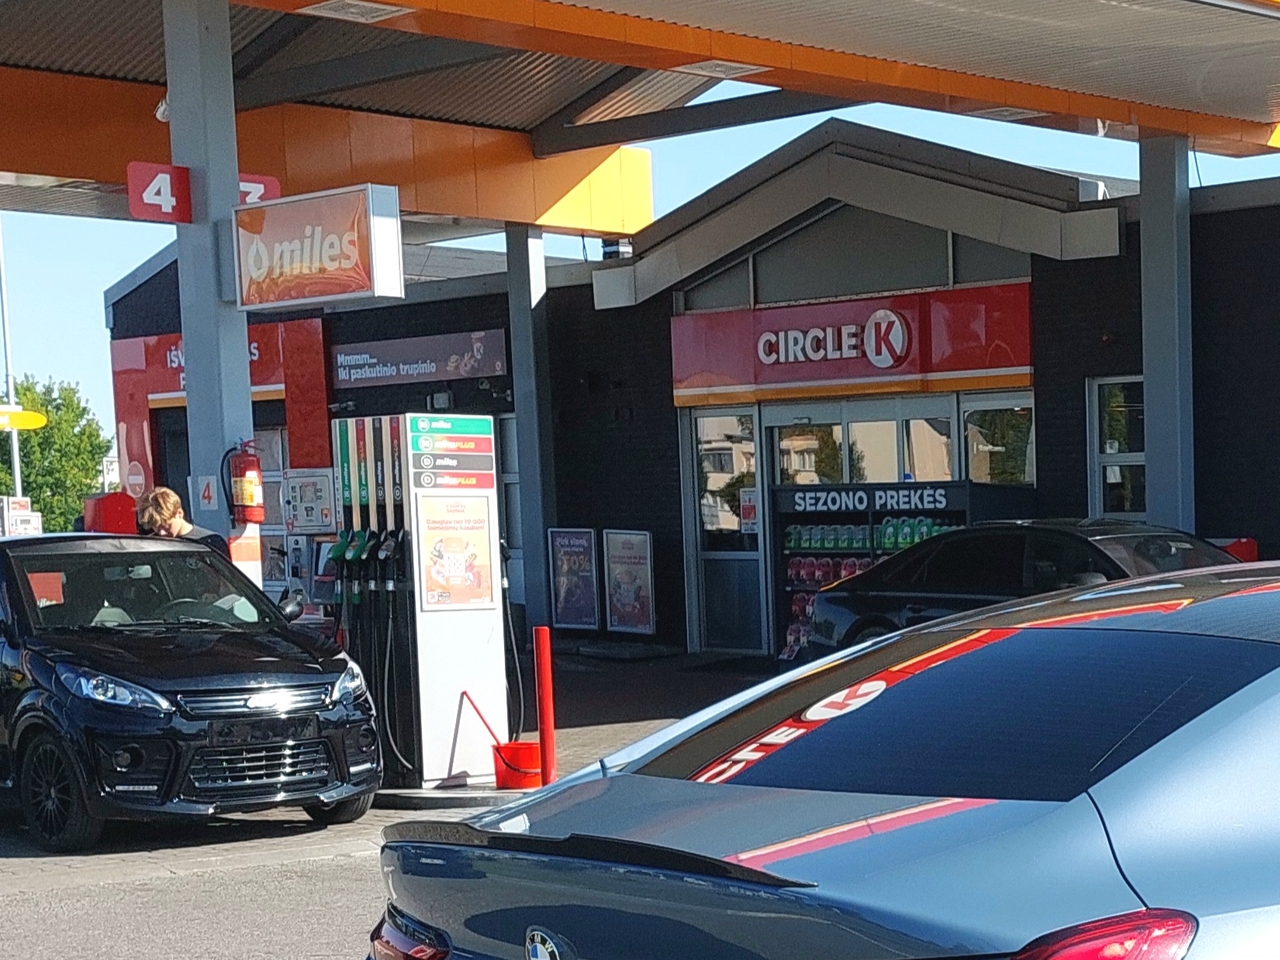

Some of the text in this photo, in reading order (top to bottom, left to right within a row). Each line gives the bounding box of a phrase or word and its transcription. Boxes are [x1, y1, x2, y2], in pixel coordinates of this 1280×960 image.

[142, 173, 176, 213] 4
[273, 225, 358, 278] miles
[757, 319, 903, 366] CIRCLE K
[338, 360, 437, 382] Iki paskutinio trupinio
[436, 457, 457, 467] miles
[202, 482, 212, 504] 4
[794, 486, 947, 511] SEZONO PREKĖS
